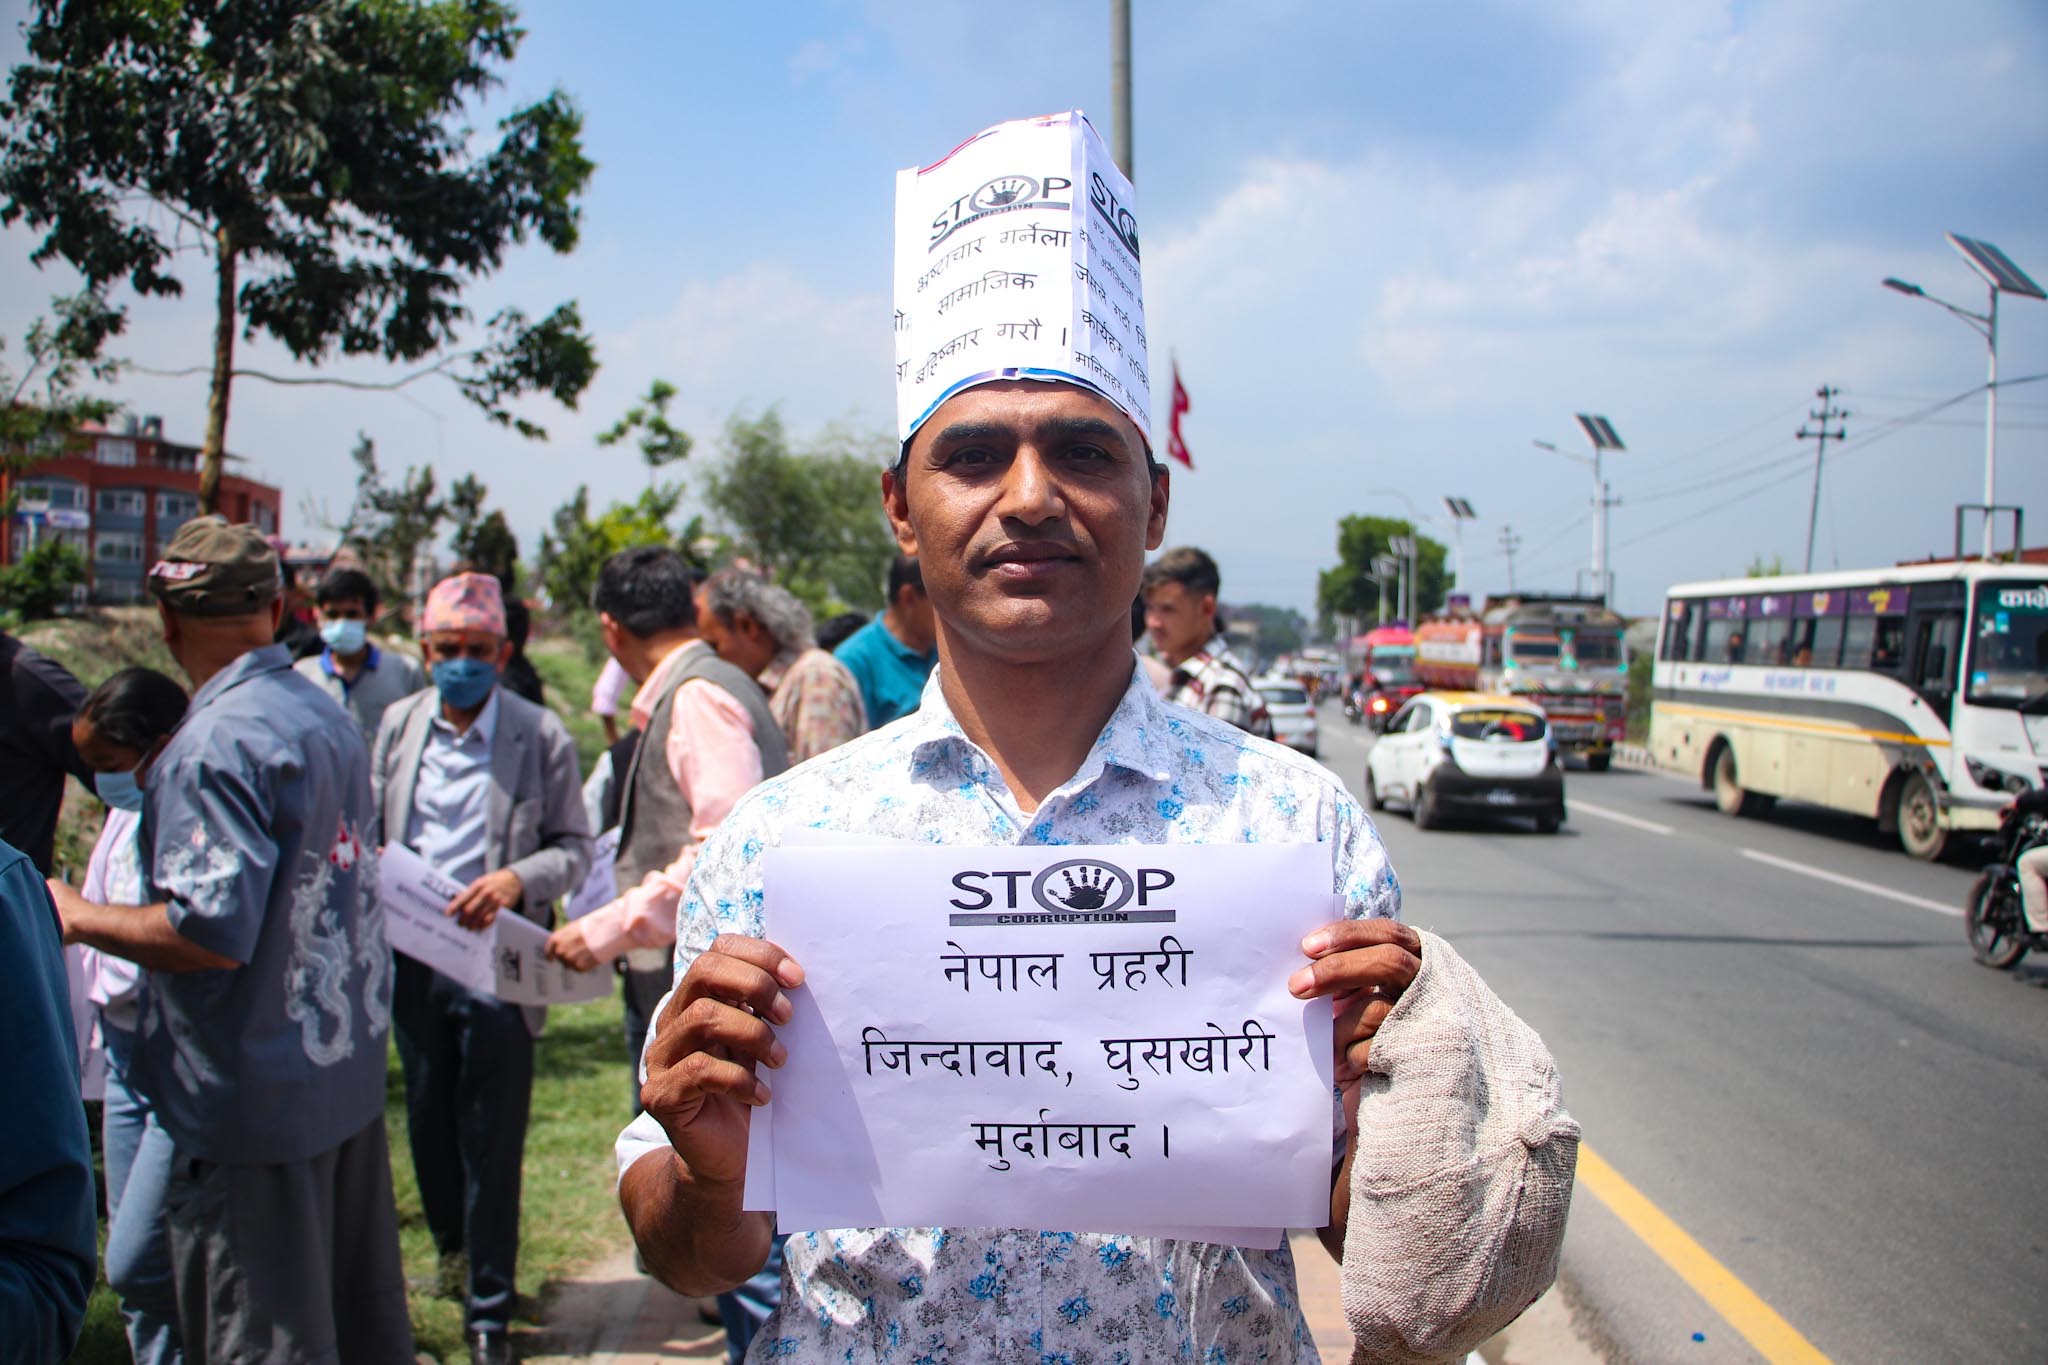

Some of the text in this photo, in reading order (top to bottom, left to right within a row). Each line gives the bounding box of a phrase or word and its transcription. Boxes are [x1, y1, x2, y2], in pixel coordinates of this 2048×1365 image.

[930, 175, 1072, 241] STOP
[1000, 222, 1072, 248] गर्नेला
[937, 270, 1038, 315] सामाजिक
[915, 328, 983, 385] बहिष्कार
[949, 859, 1176, 912] STOP
[996, 912, 1130, 925] CORRUPTION
[940, 936, 1194, 992] नेपाल प्रहरी
[861, 1020, 1276, 1091] जिन्दावाद, घुसखोरी
[971, 1108, 1136, 1171] मुर्दाबाद
